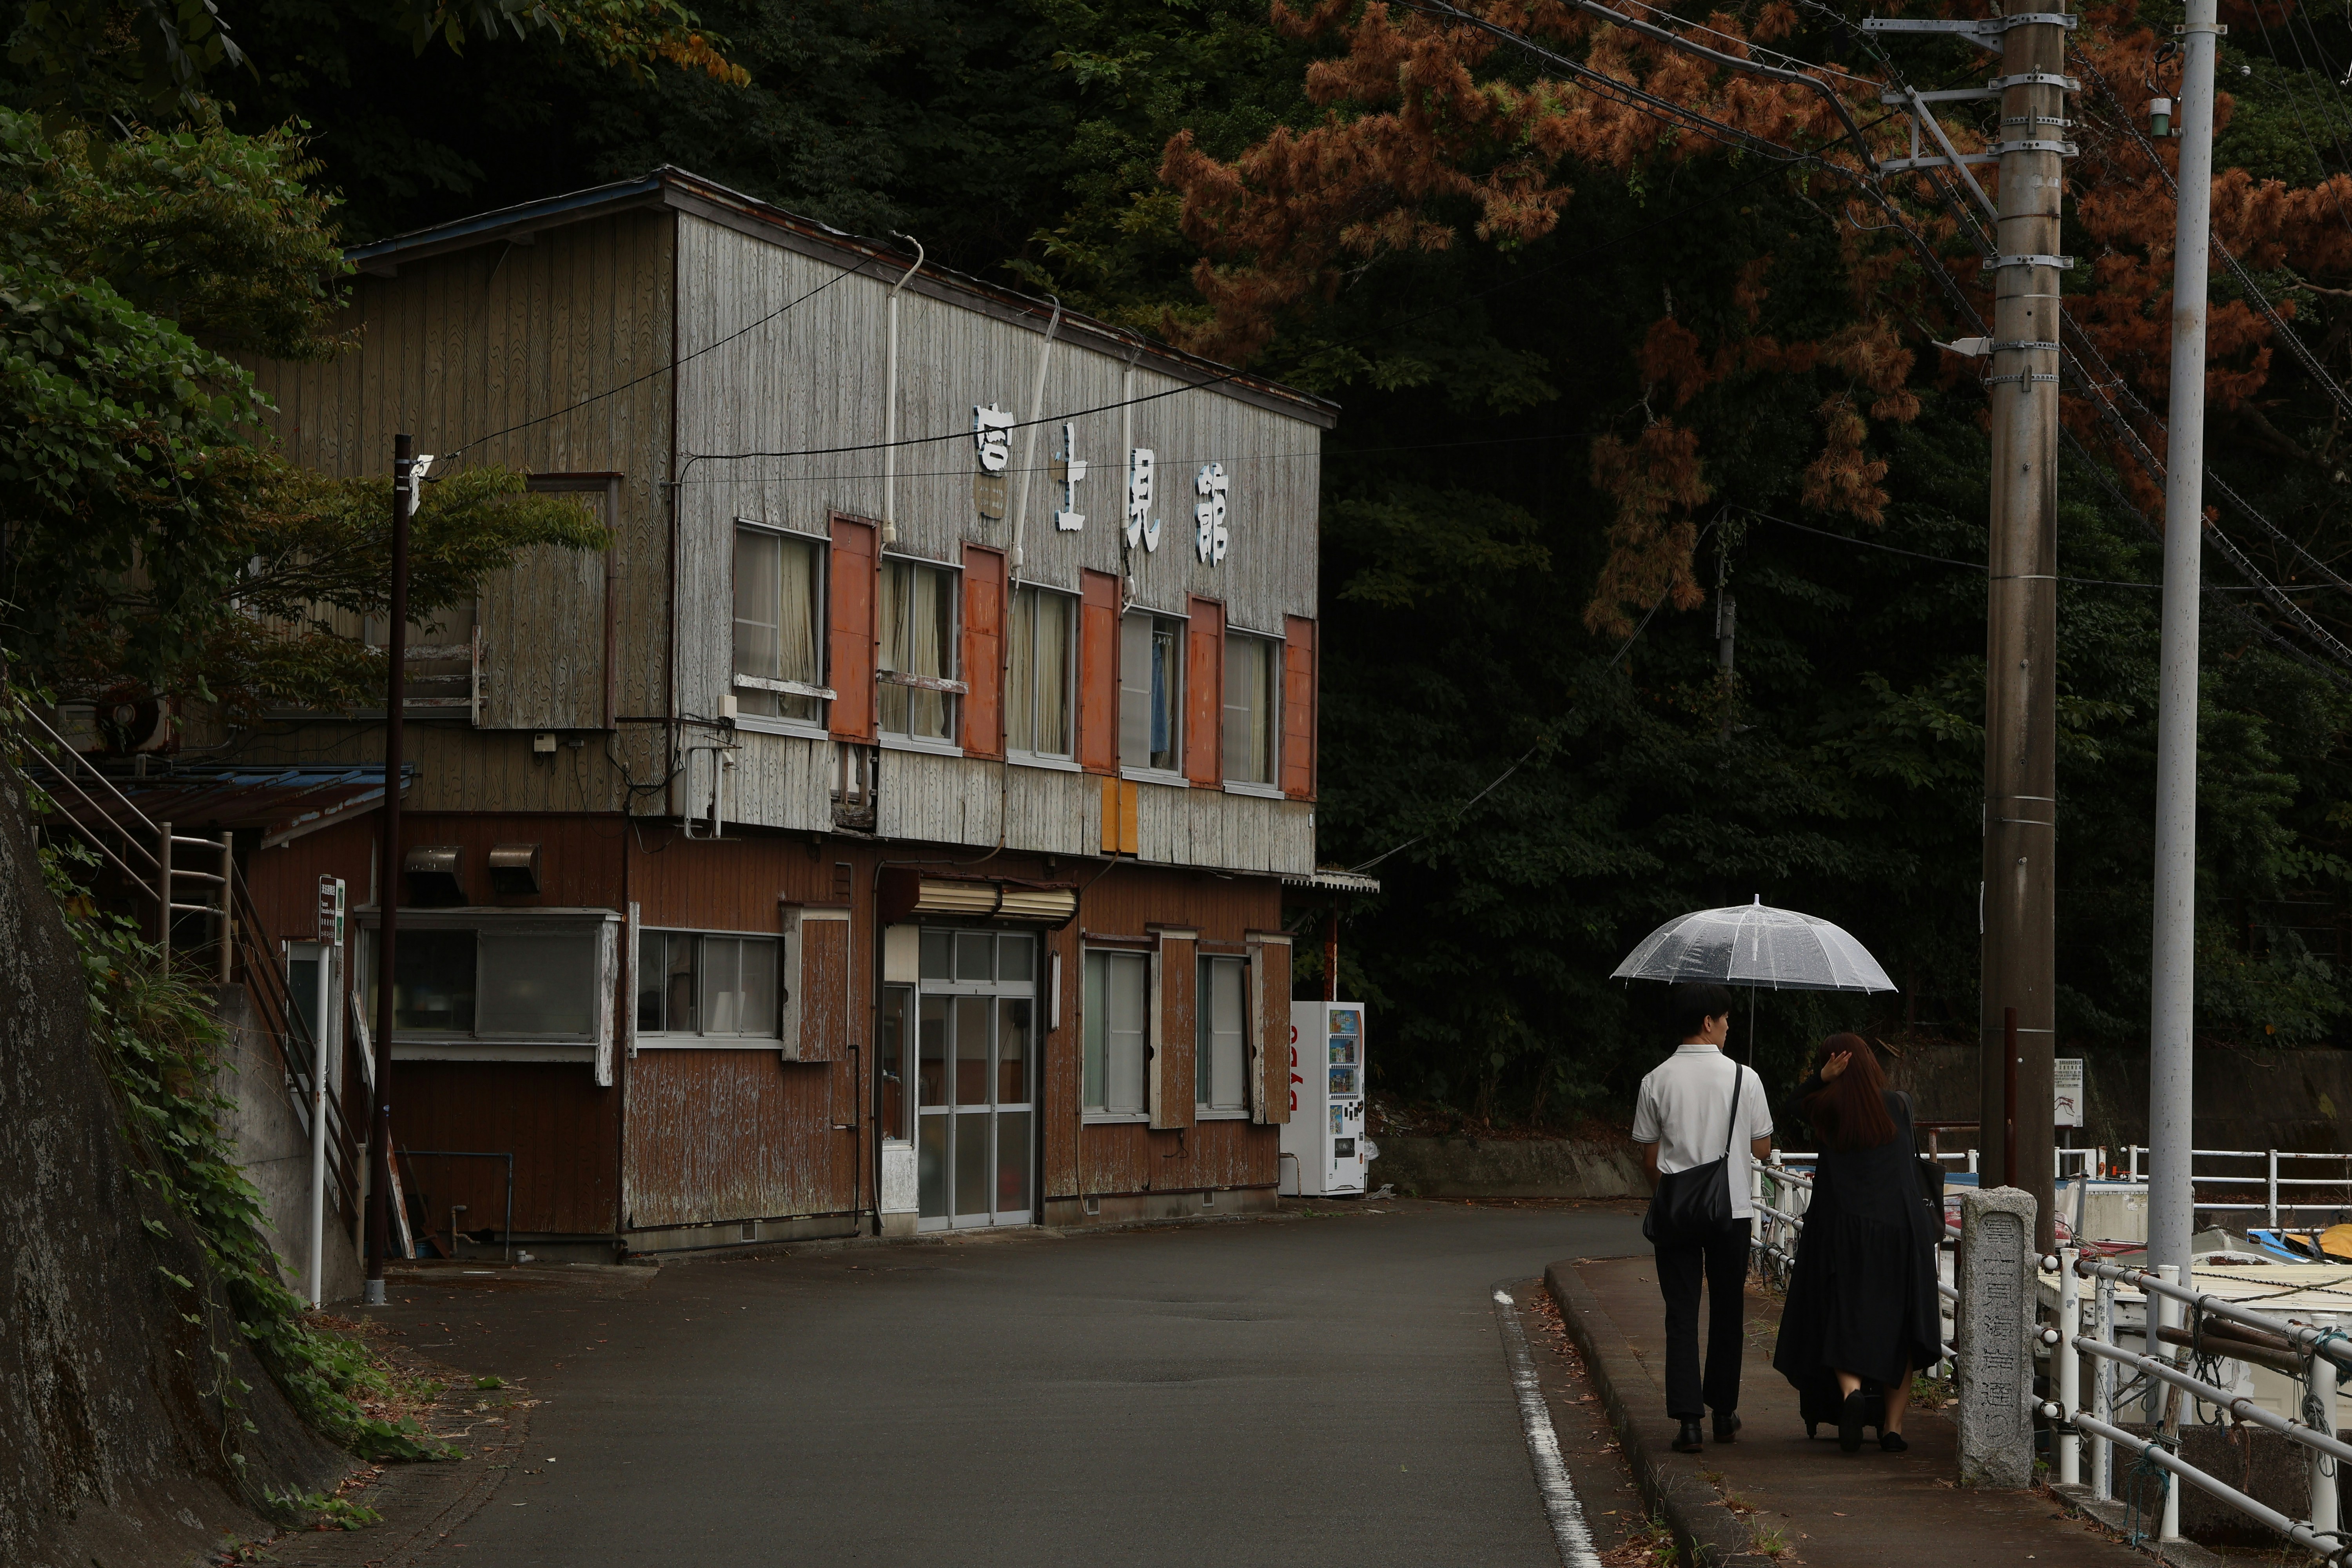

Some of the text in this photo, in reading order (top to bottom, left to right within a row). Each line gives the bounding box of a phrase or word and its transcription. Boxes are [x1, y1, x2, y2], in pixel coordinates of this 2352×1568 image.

[321, 884, 335, 896] 津波避難路
[1981, 1219, 2016, 1439] 富士見海岸通り
